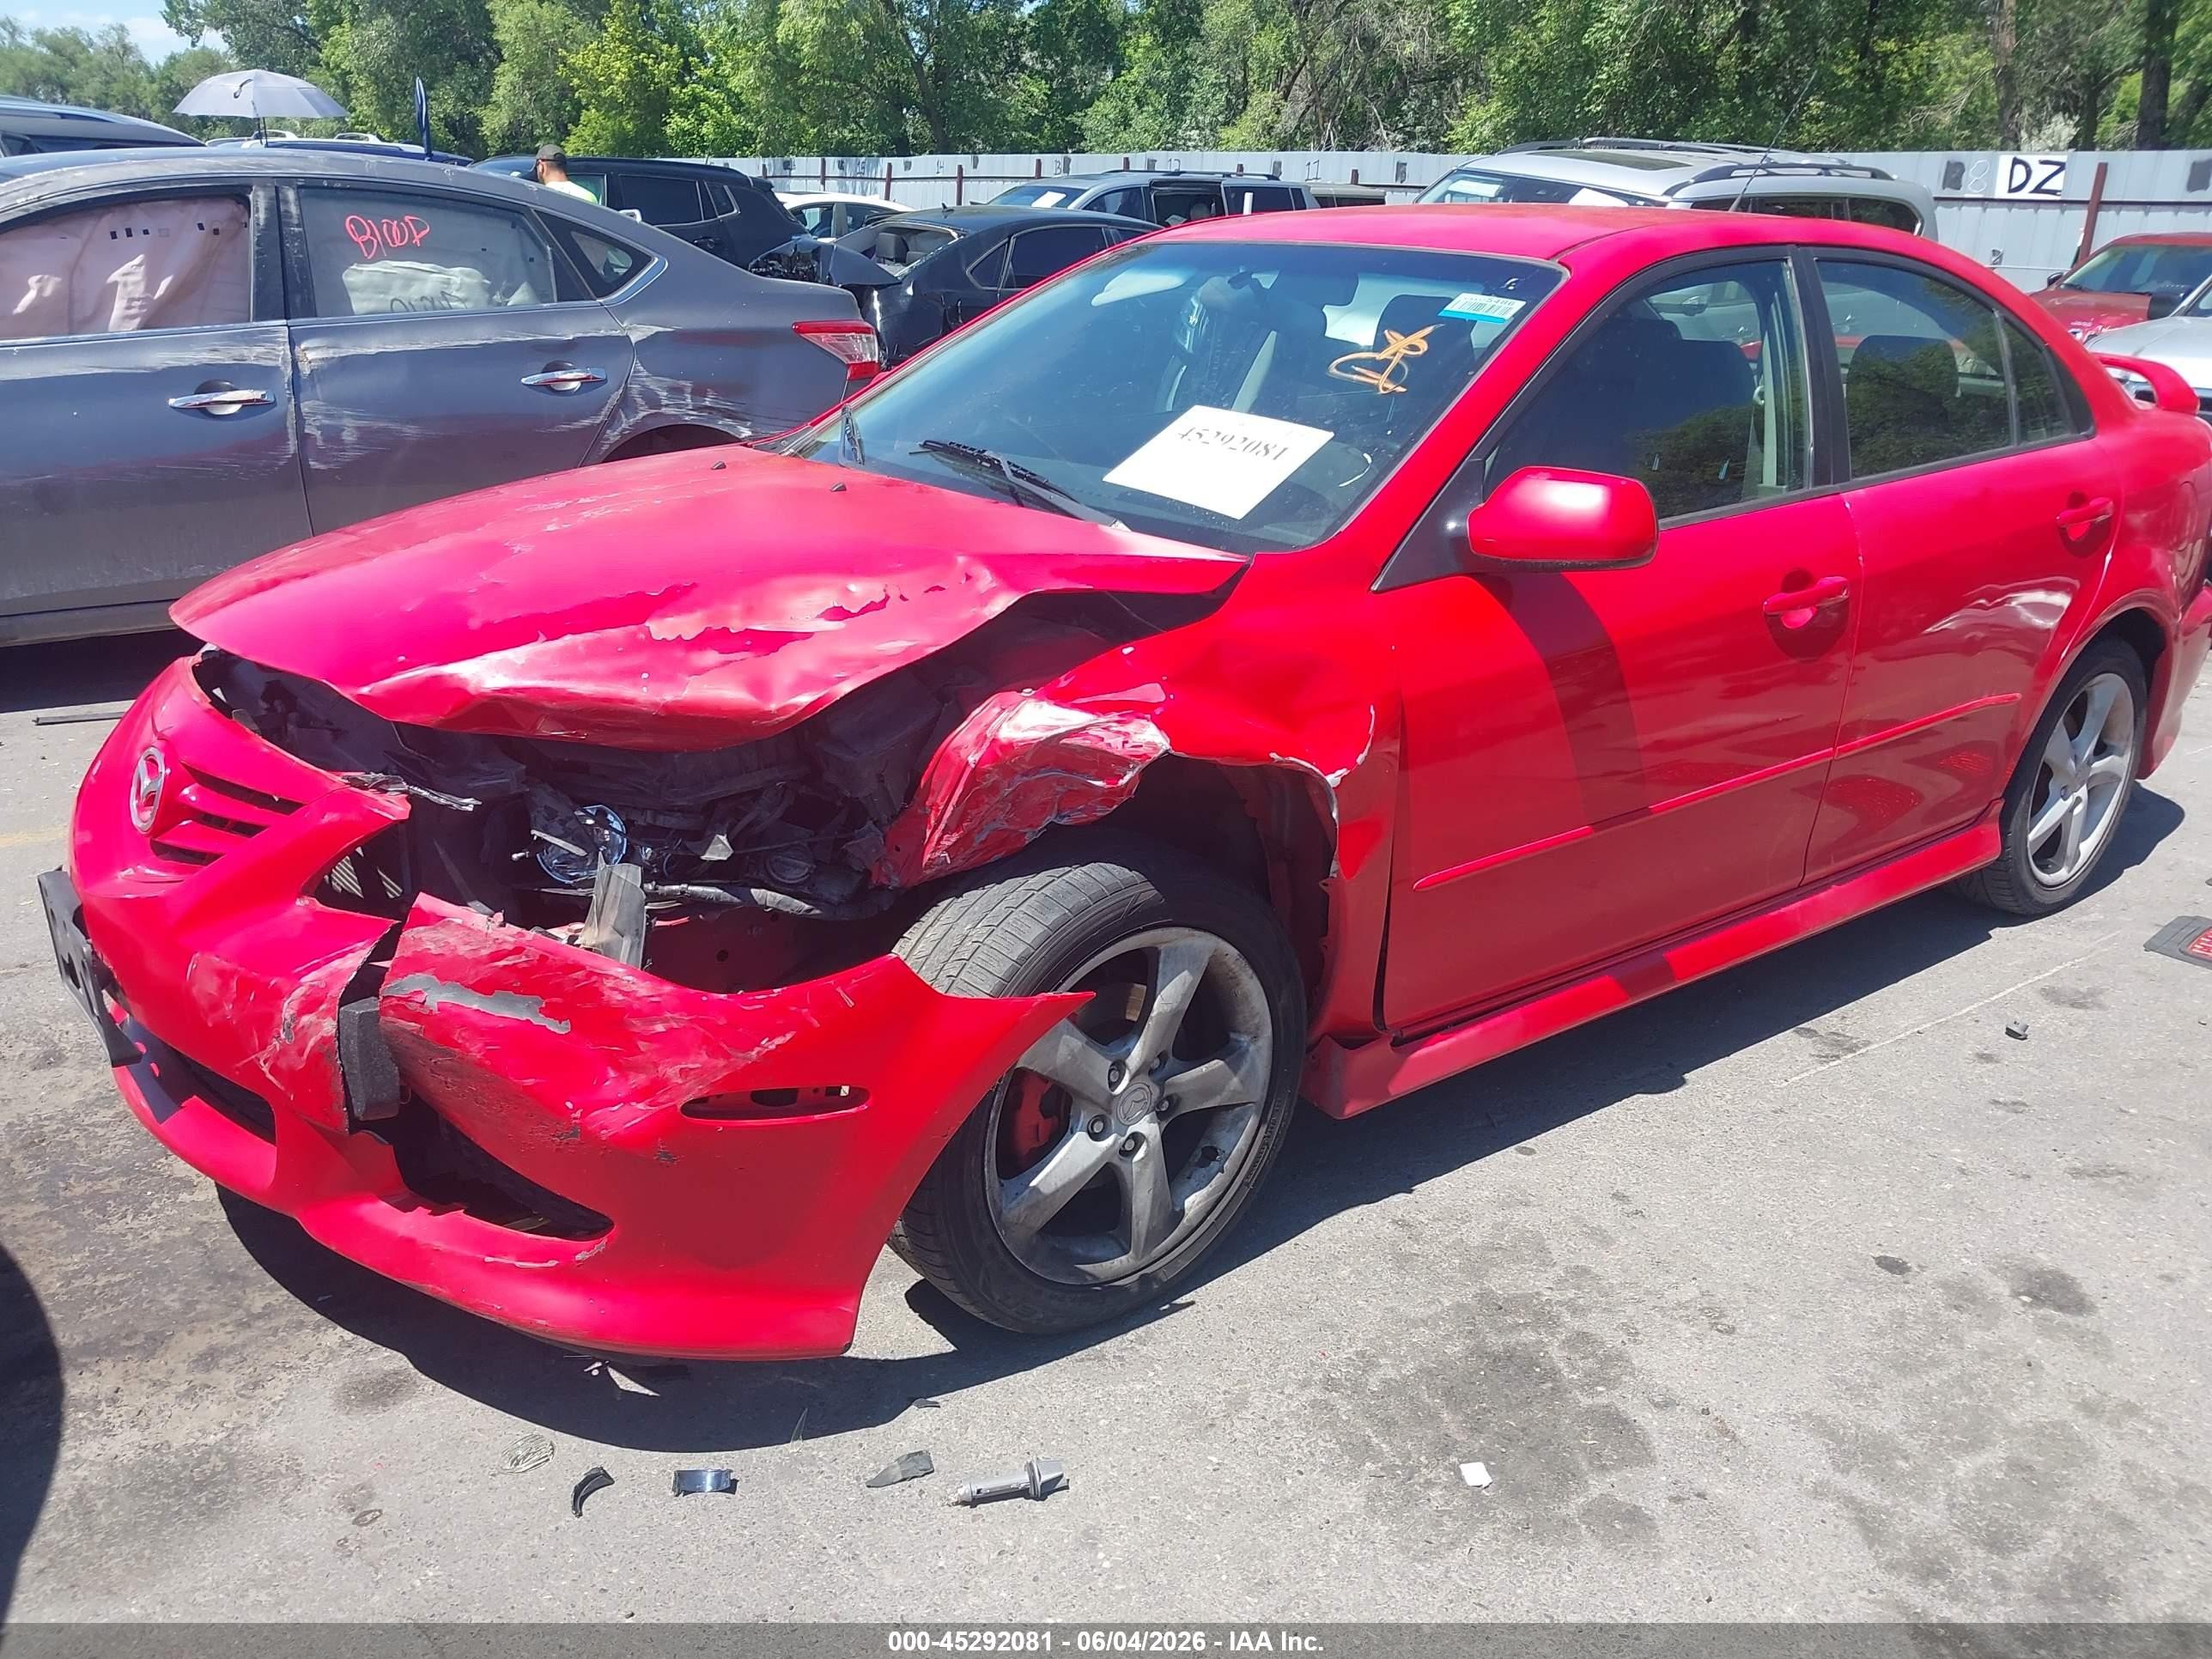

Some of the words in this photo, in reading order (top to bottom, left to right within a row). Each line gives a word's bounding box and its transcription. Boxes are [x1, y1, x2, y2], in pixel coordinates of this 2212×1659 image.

[1304, 159, 1322, 182] 11
[2007, 155, 2067, 196] DZ
[1178, 427, 1289, 460] 45292081
